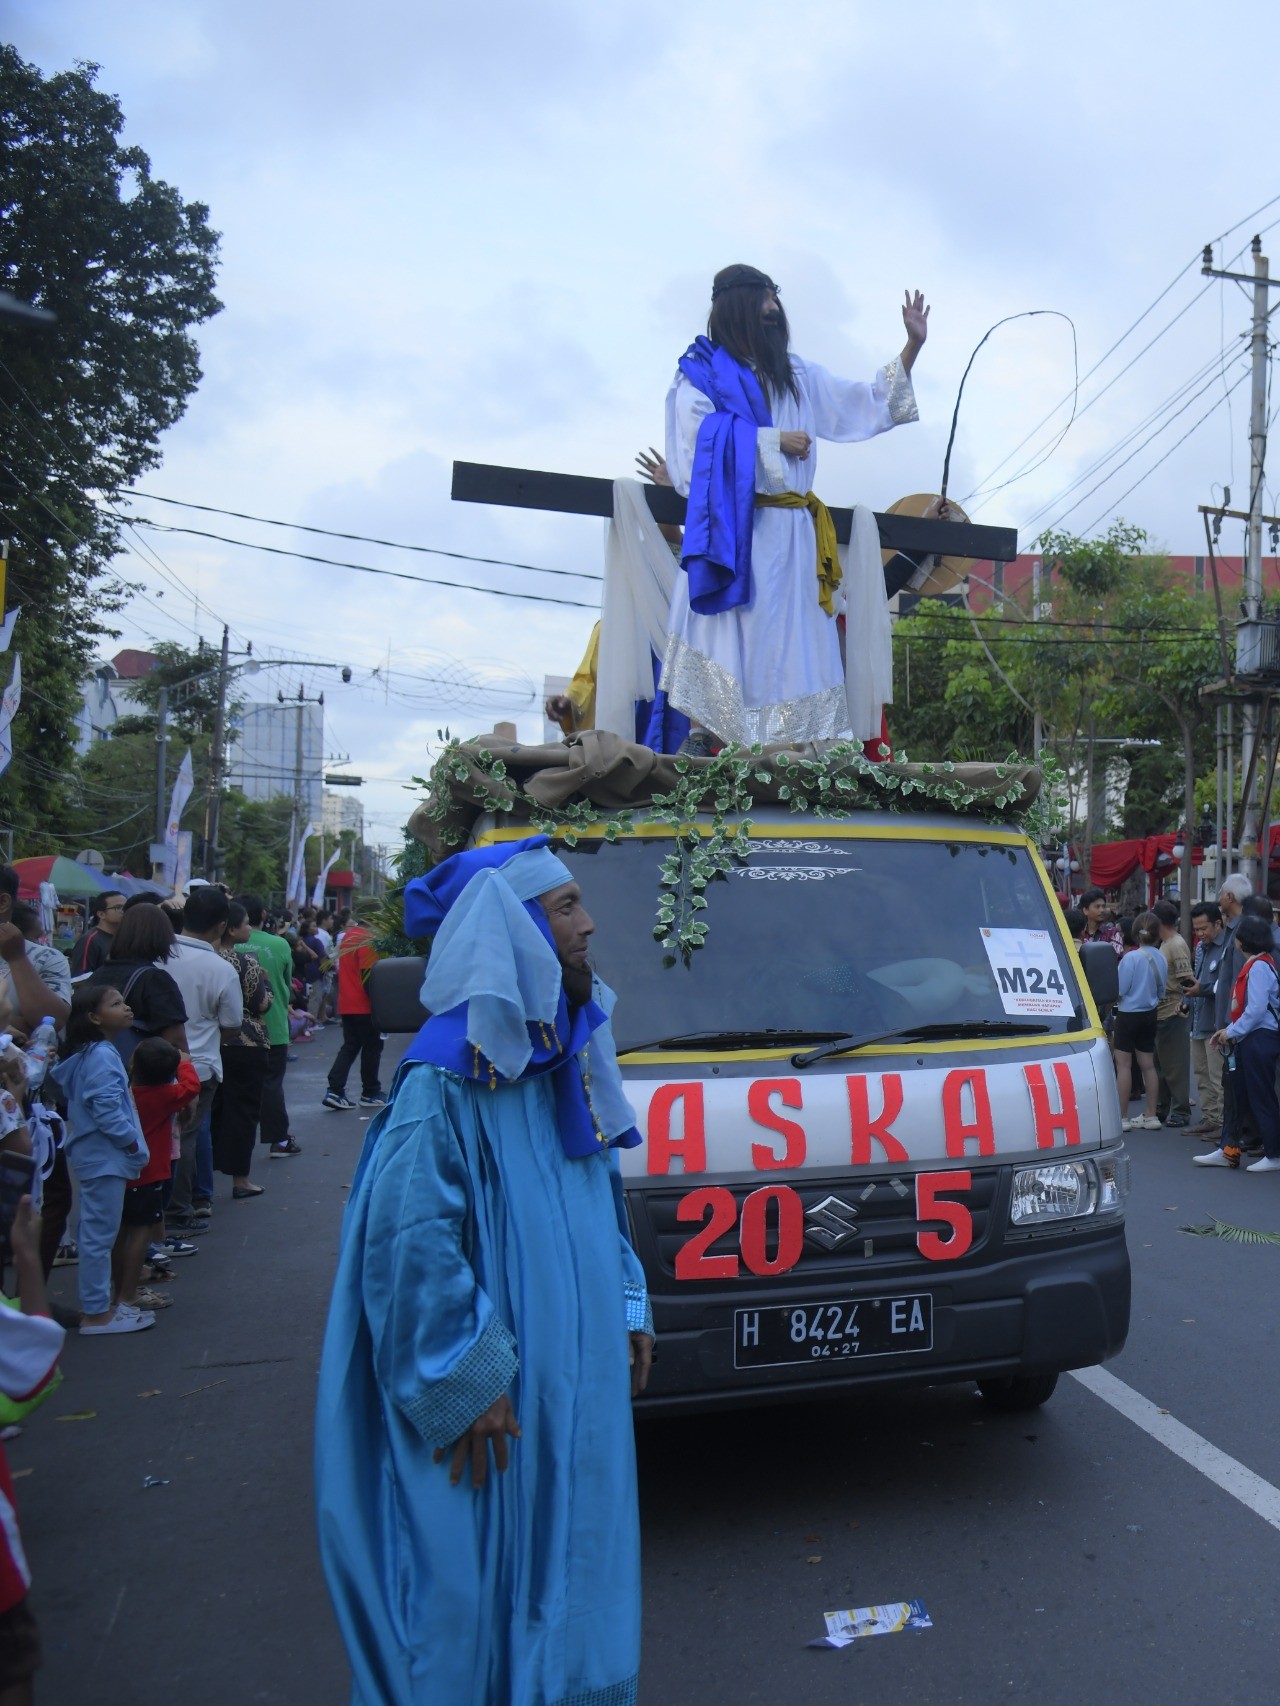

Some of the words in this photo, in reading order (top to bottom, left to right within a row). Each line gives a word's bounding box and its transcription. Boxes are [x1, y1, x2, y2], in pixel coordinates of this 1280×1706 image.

[997, 967, 1064, 995] M24
[742, 1312, 759, 1347] H
[790, 1305, 860, 1344] 8424
[891, 1299, 925, 1334] EA
